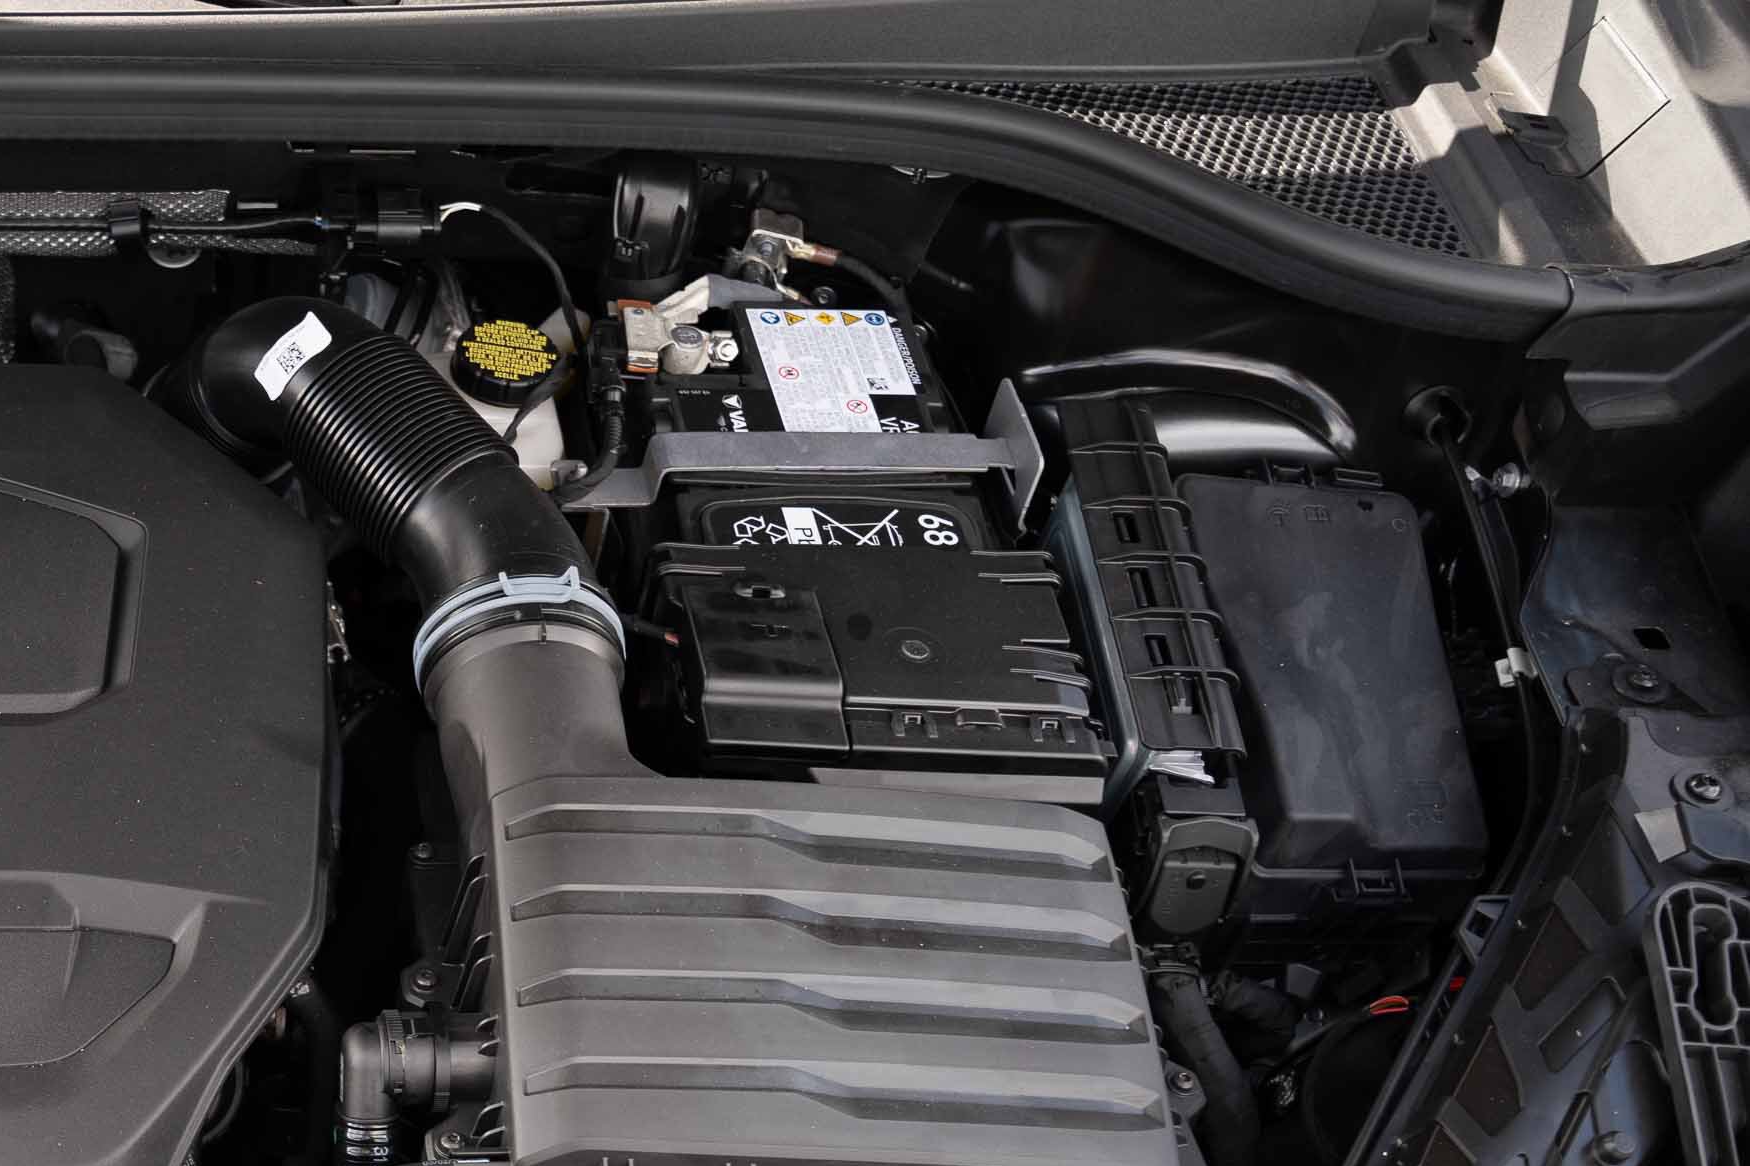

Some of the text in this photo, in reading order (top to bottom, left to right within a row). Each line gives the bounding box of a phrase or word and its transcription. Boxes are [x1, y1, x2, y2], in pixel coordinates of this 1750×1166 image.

[891, 327, 922, 385] DANGER/POISON
[729, 410, 749, 432] VA
[917, 514, 959, 546] 68
